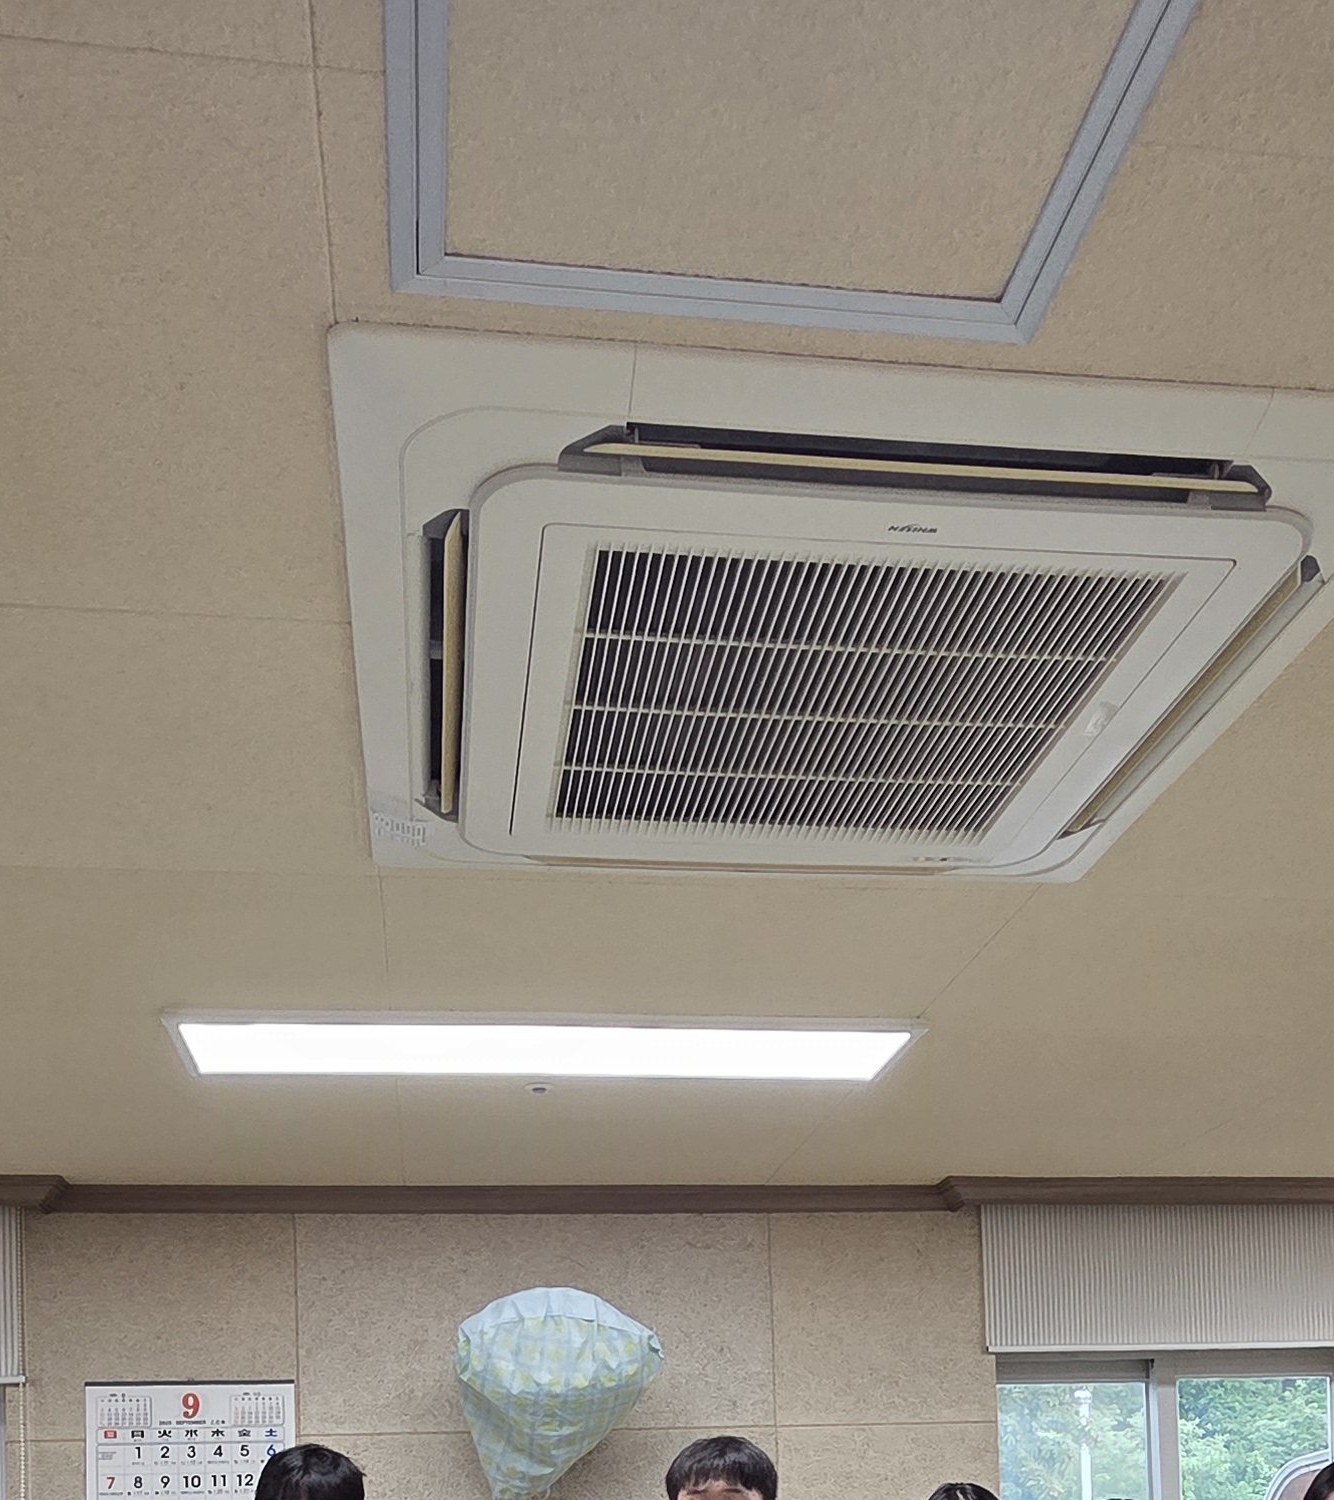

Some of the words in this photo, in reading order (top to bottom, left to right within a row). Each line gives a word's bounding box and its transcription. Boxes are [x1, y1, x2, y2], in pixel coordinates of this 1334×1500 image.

[181, 1392, 200, 1419] 9
[157, 1429, 172, 1438] 火
[185, 1429, 199, 1438] 水
[211, 1429, 225, 1438] 木
[265, 1428, 278, 1438] 土
[135, 1446, 142, 1459] 1
[160, 1446, 170, 1459] 2
[187, 1445, 196, 1459] 3
[213, 1445, 223, 1457] 4
[240, 1444, 250, 1457] 5
[267, 1444, 276, 1457] 6
[106, 1476, 116, 1489] 7
[133, 1475, 143, 1489] 8
[160, 1475, 170, 1488] 9
[183, 1475, 201, 1488] 10
[211, 1474, 227, 1487] 11
[237, 1474, 254, 1487] 12
